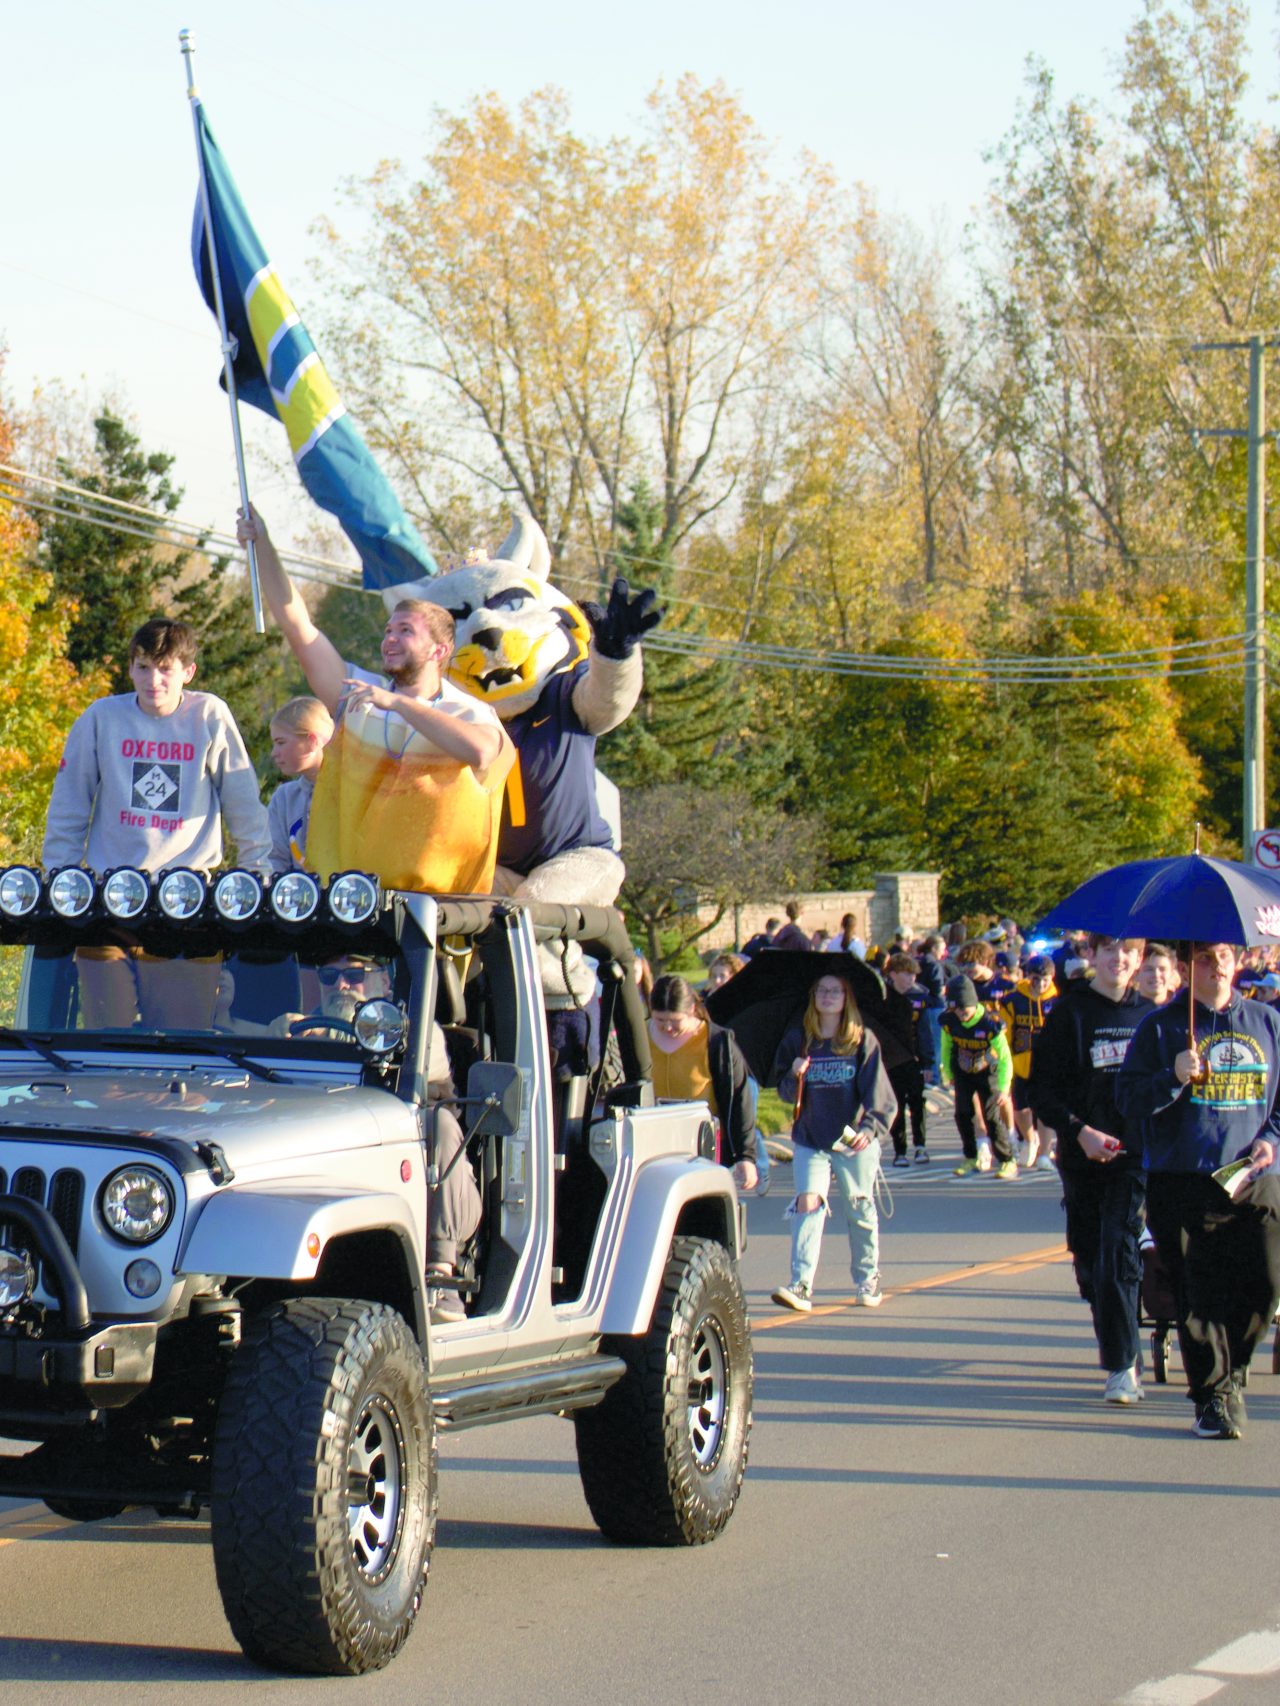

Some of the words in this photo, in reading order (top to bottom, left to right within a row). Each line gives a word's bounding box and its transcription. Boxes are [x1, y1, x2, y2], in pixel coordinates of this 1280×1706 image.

[122, 739, 194, 761] OXFORD
[152, 773, 160, 781] M
[144, 780, 167, 798] 24
[120, 811, 145, 827] Fire
[151, 815, 184, 832] Dept
[953, 1037, 988, 1049] FORD
[1222, 1031, 1250, 1042] School
[1192, 1083, 1265, 1101] CATCHER
